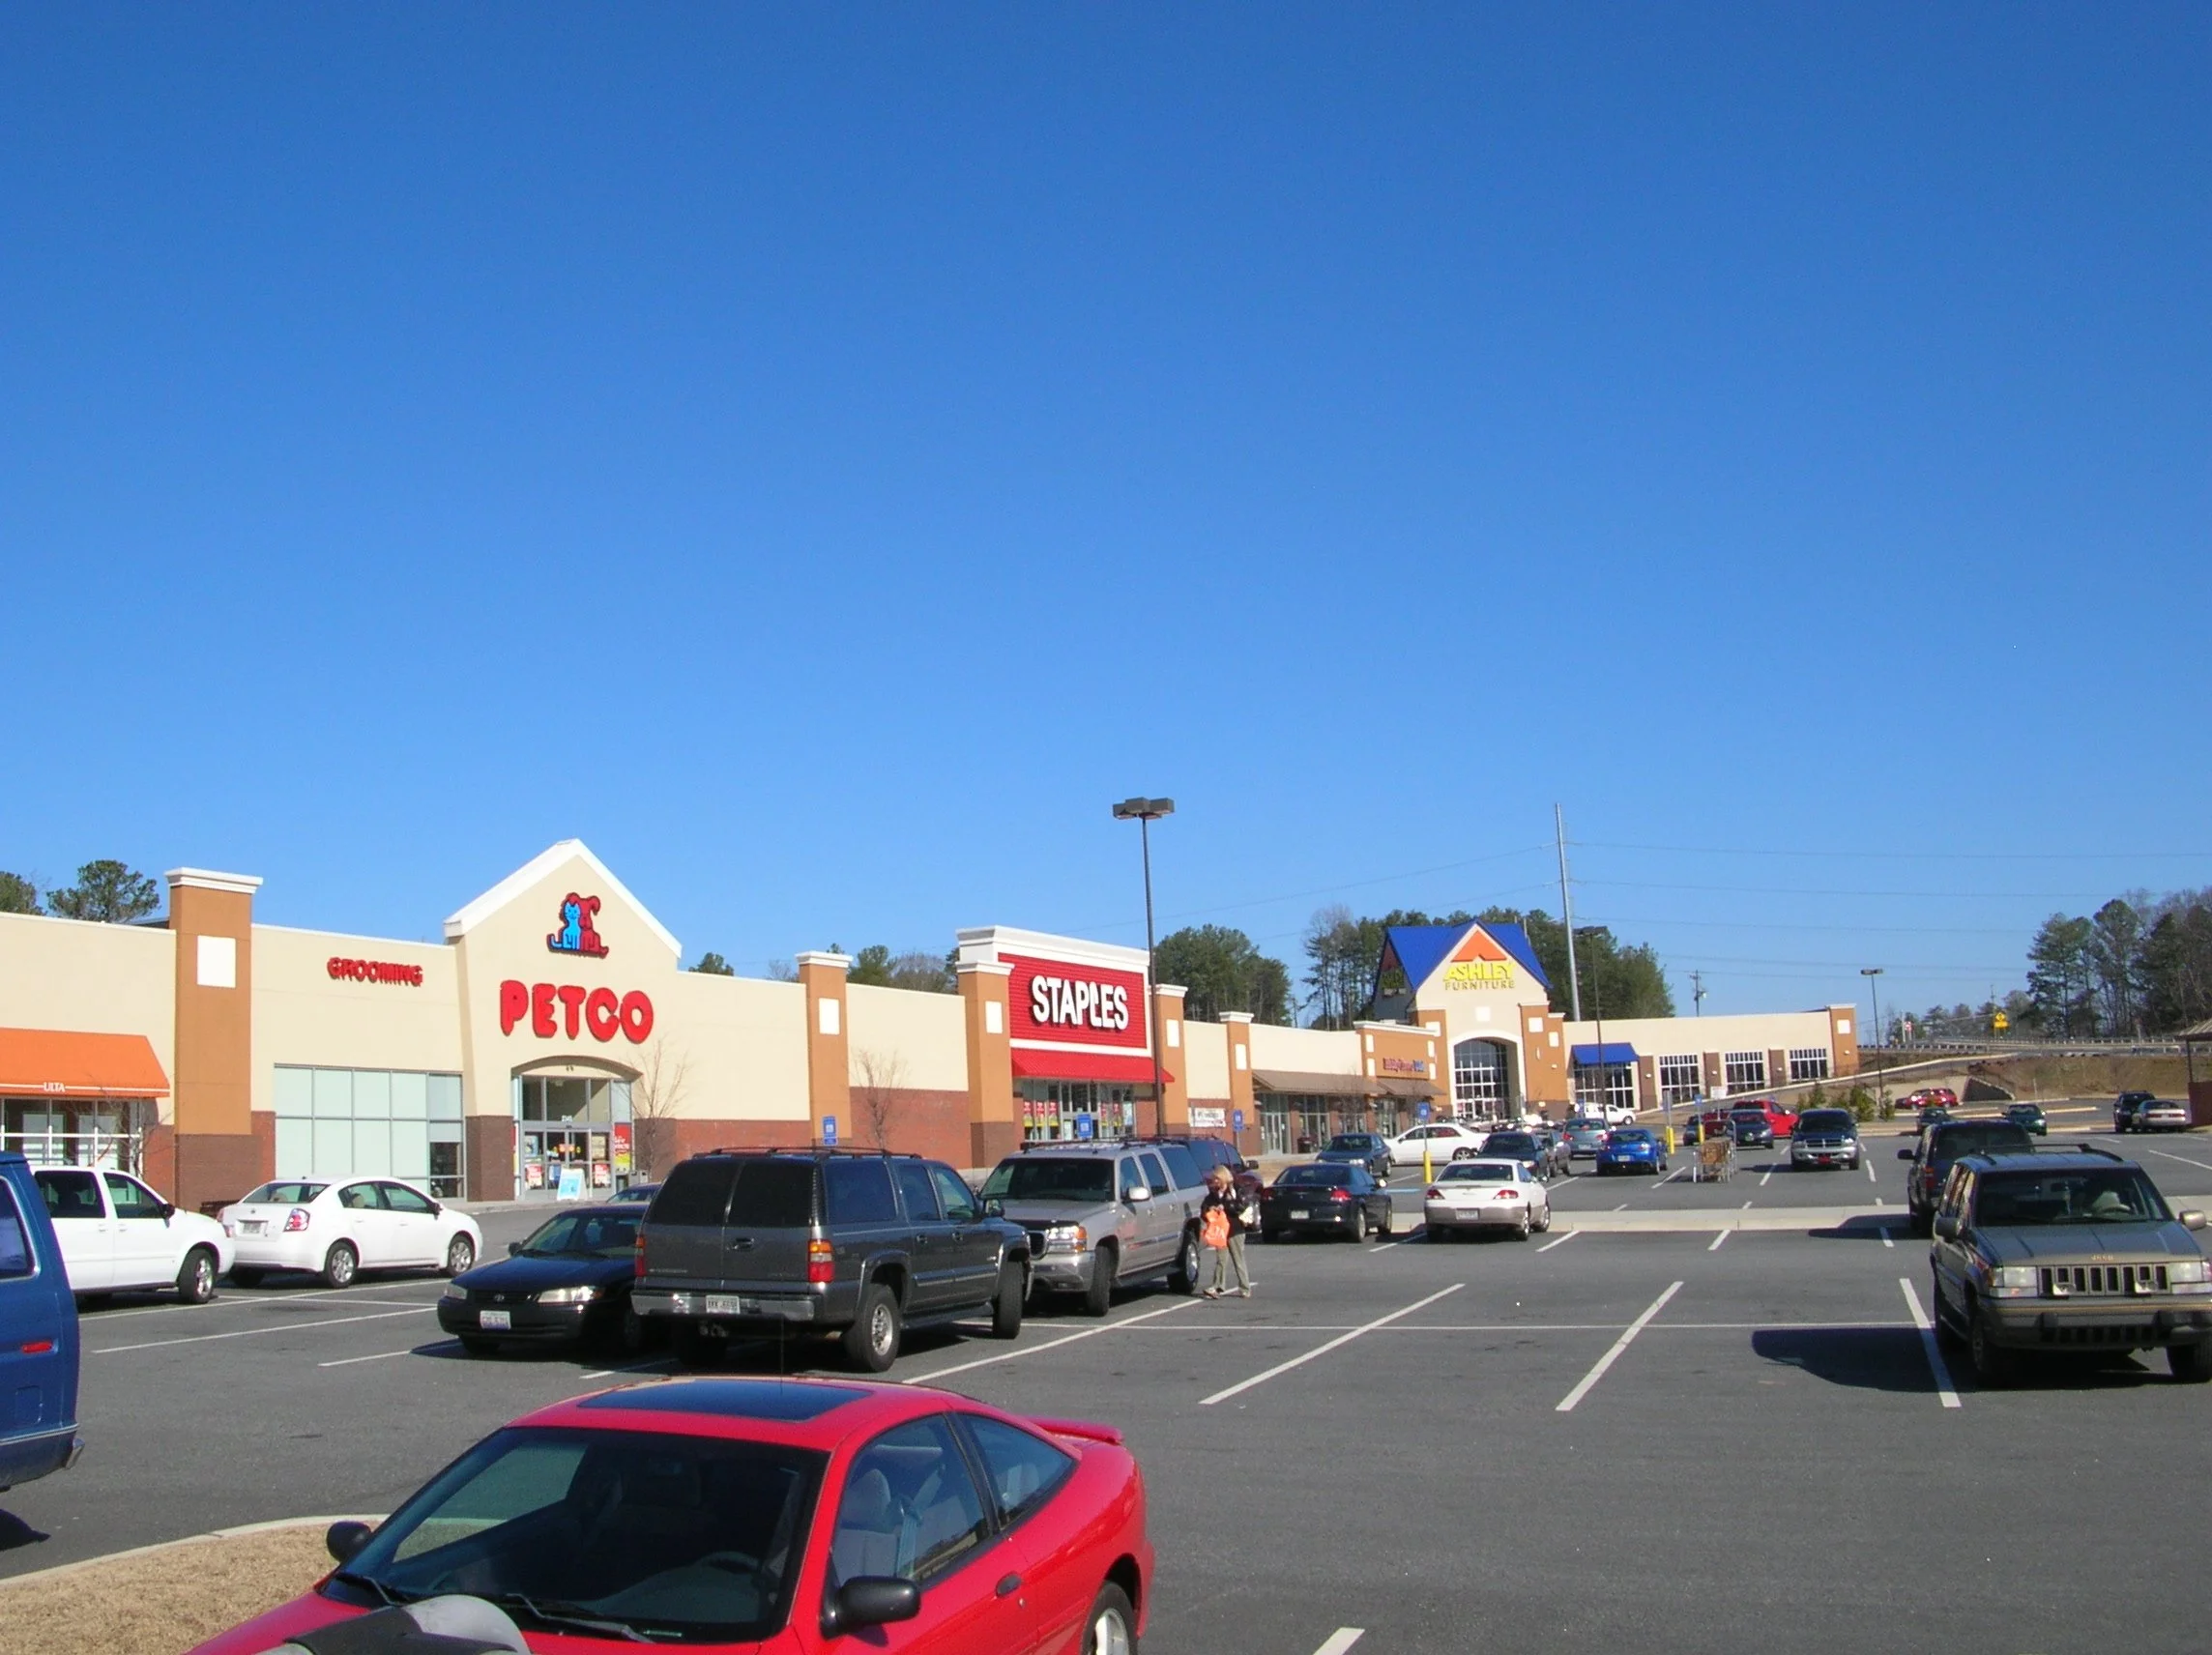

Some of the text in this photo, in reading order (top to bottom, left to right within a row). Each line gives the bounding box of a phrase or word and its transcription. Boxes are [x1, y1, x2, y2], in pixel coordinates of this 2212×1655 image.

[327, 957, 422, 987] GROOMING
[1443, 962, 1515, 981] ASHLEY
[1444, 980, 1515, 991] FURNITURE
[500, 979, 654, 1044] PETCO
[1032, 974, 1129, 1031] STAPLES
[44, 1082, 66, 1093] ULTA
